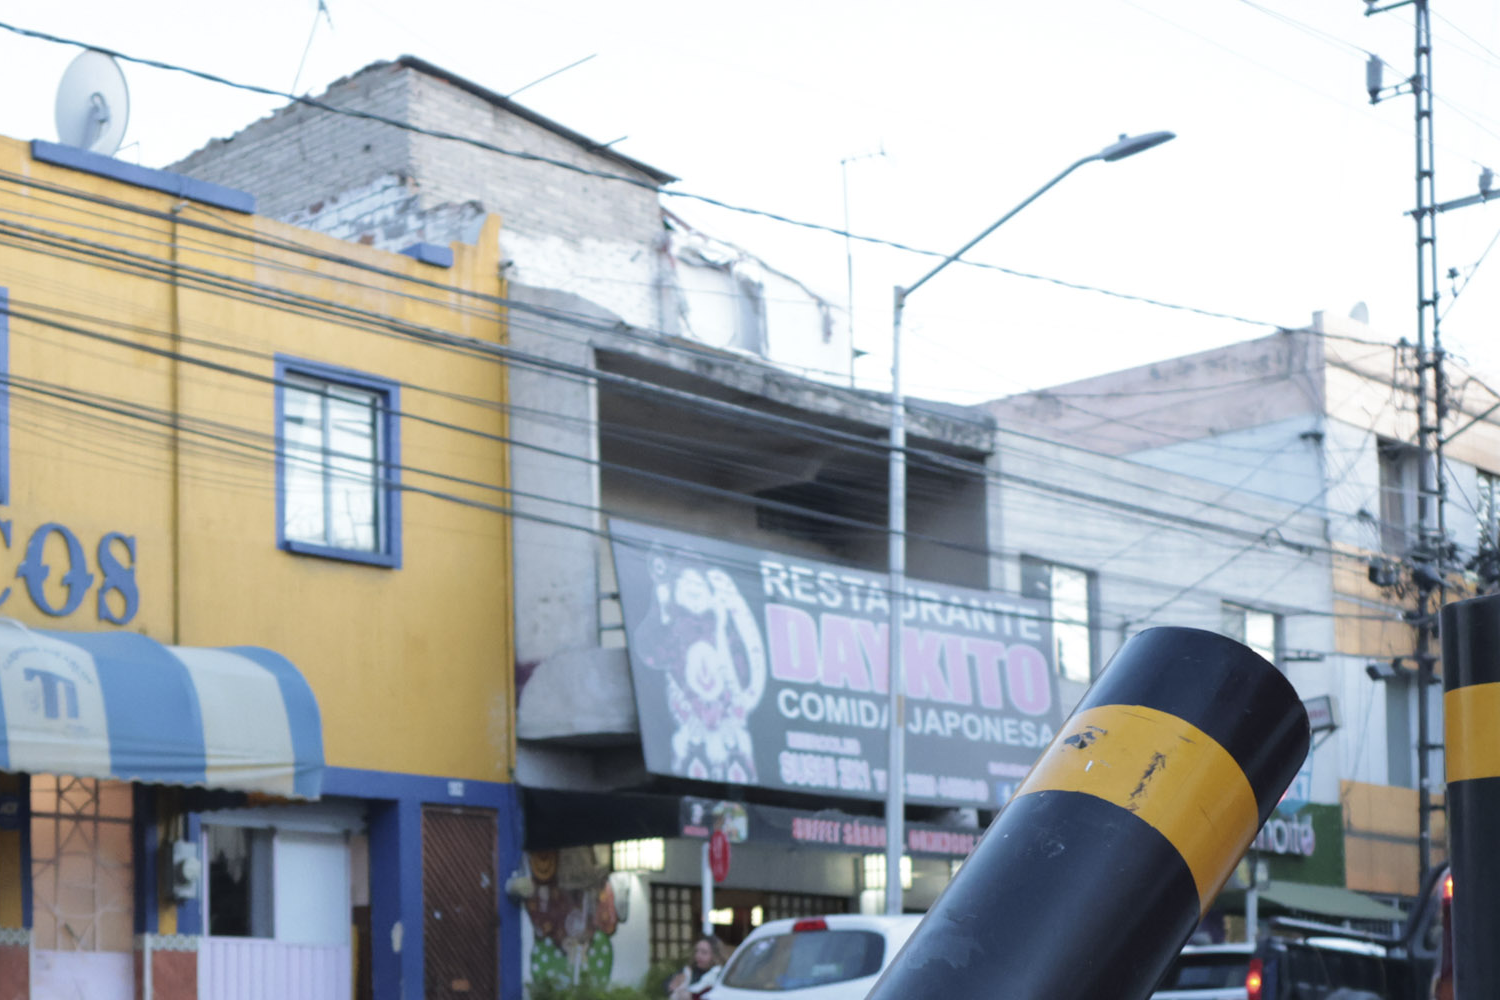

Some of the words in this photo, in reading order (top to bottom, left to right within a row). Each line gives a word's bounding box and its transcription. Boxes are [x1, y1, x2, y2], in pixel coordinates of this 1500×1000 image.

[759, 559, 1043, 642] RESTAURANTE
[764, 602, 1052, 717] DAYKITO
[907, 707, 1055, 751] JAPONESA
